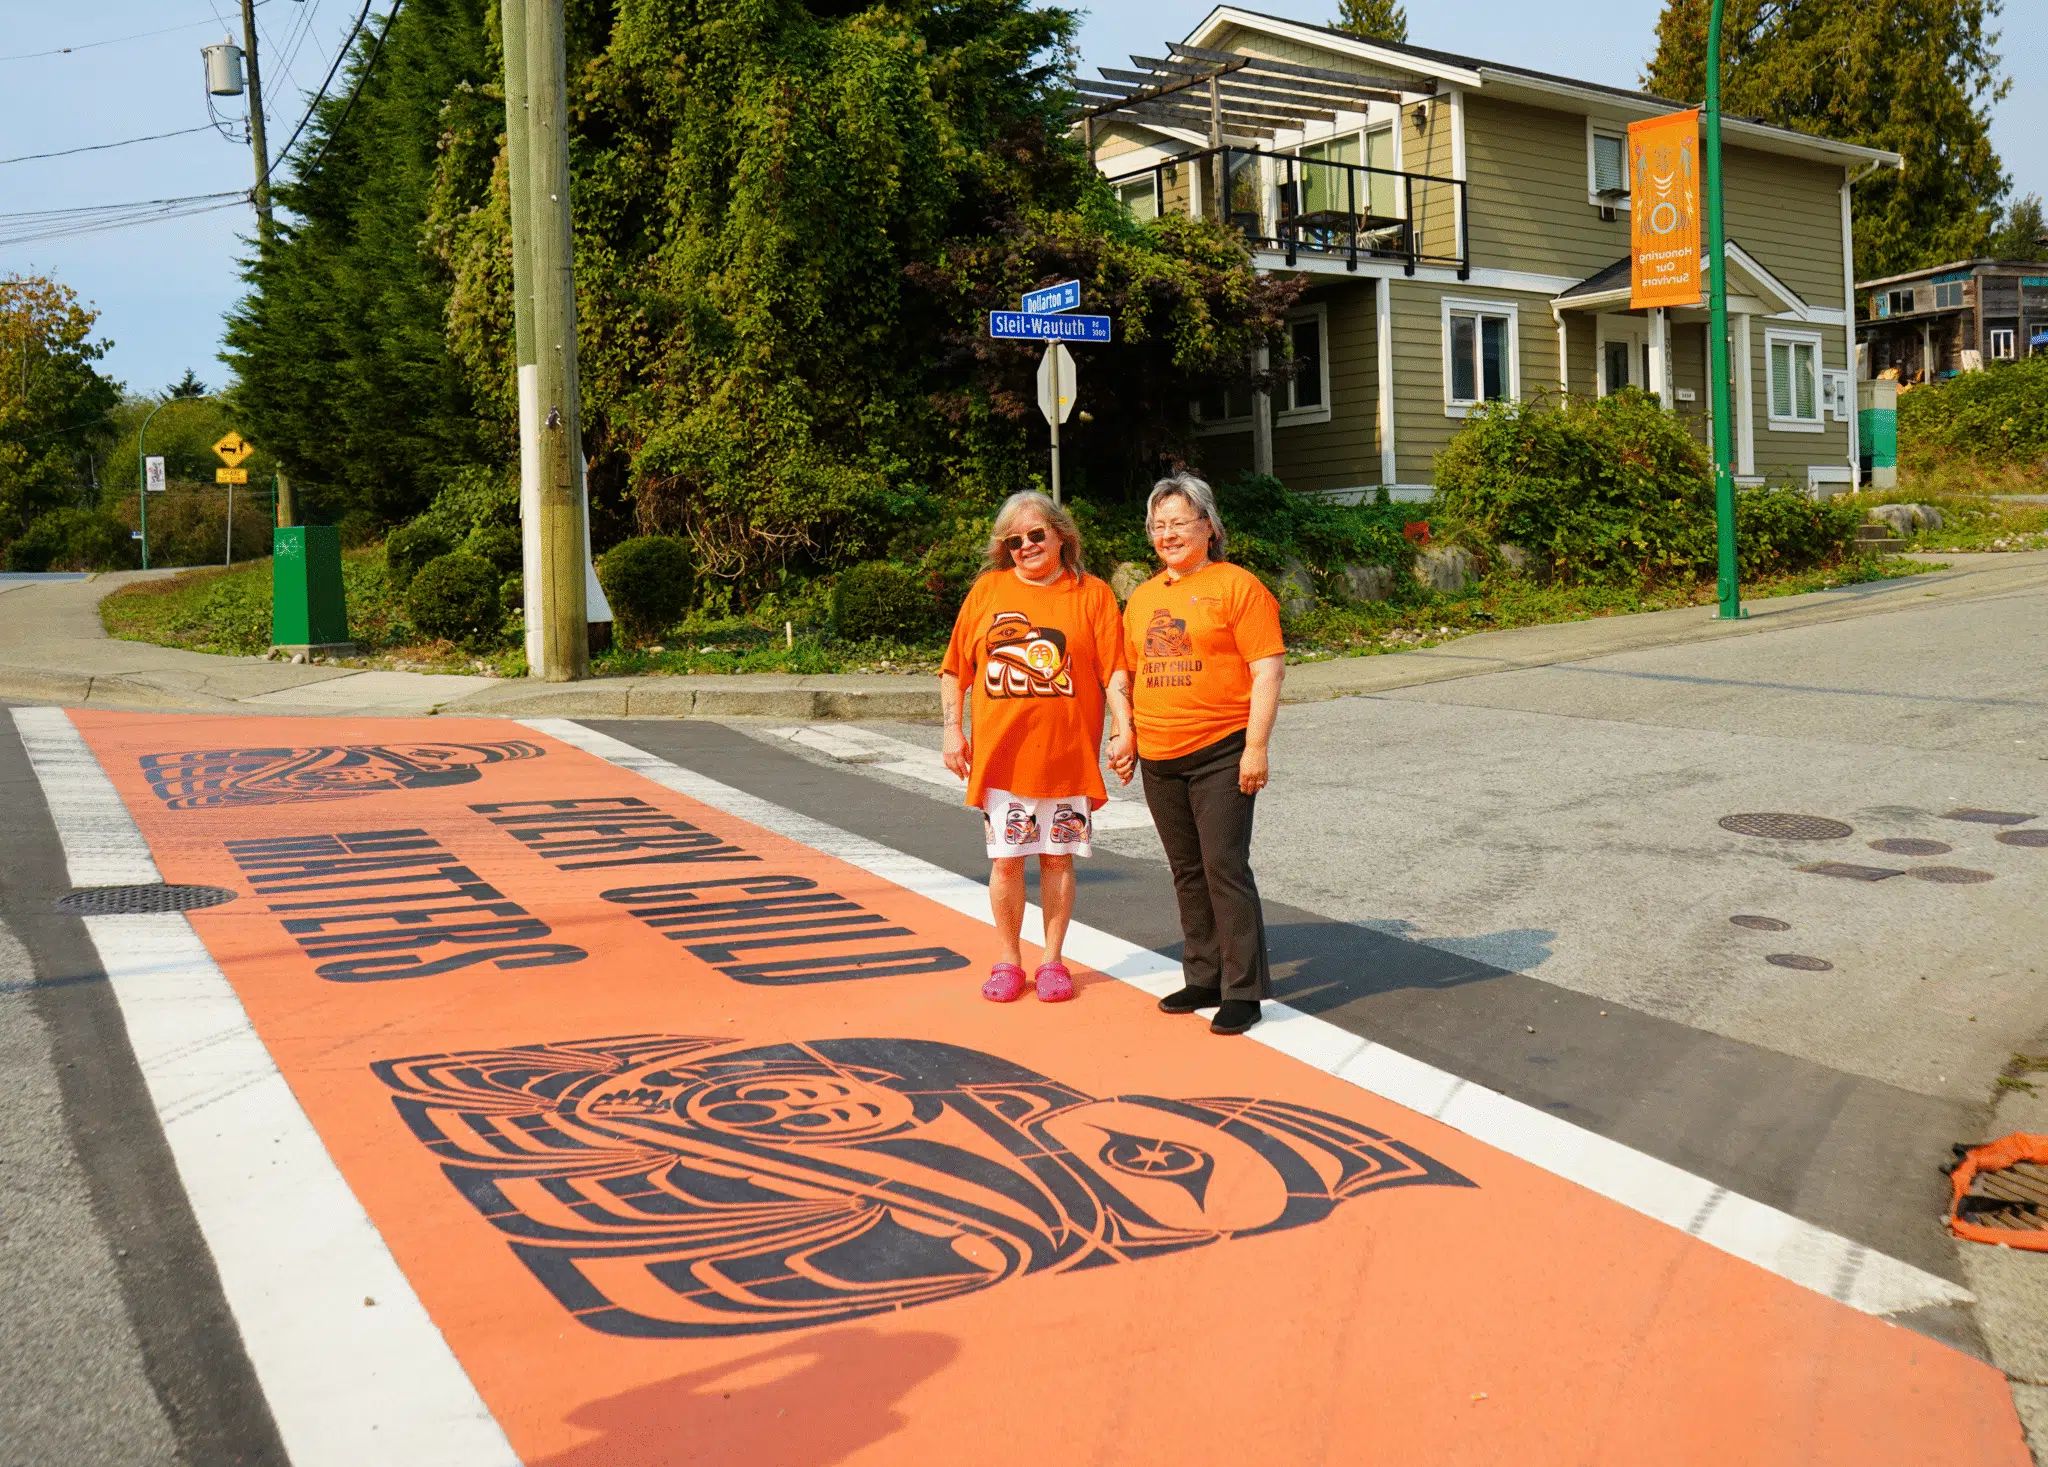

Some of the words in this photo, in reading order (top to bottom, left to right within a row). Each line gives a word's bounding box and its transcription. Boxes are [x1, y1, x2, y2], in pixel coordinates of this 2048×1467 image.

[1027, 293, 1062, 313] Dollarton
[996, 315, 1085, 336] Sleil-Waututh
[1170, 660, 1203, 672] CHILD
[1146, 675, 1192, 688] MATTERS
[467, 796, 765, 871] EVERY
[222, 828, 589, 983] MATTERS
[599, 875, 971, 986] CHILD
